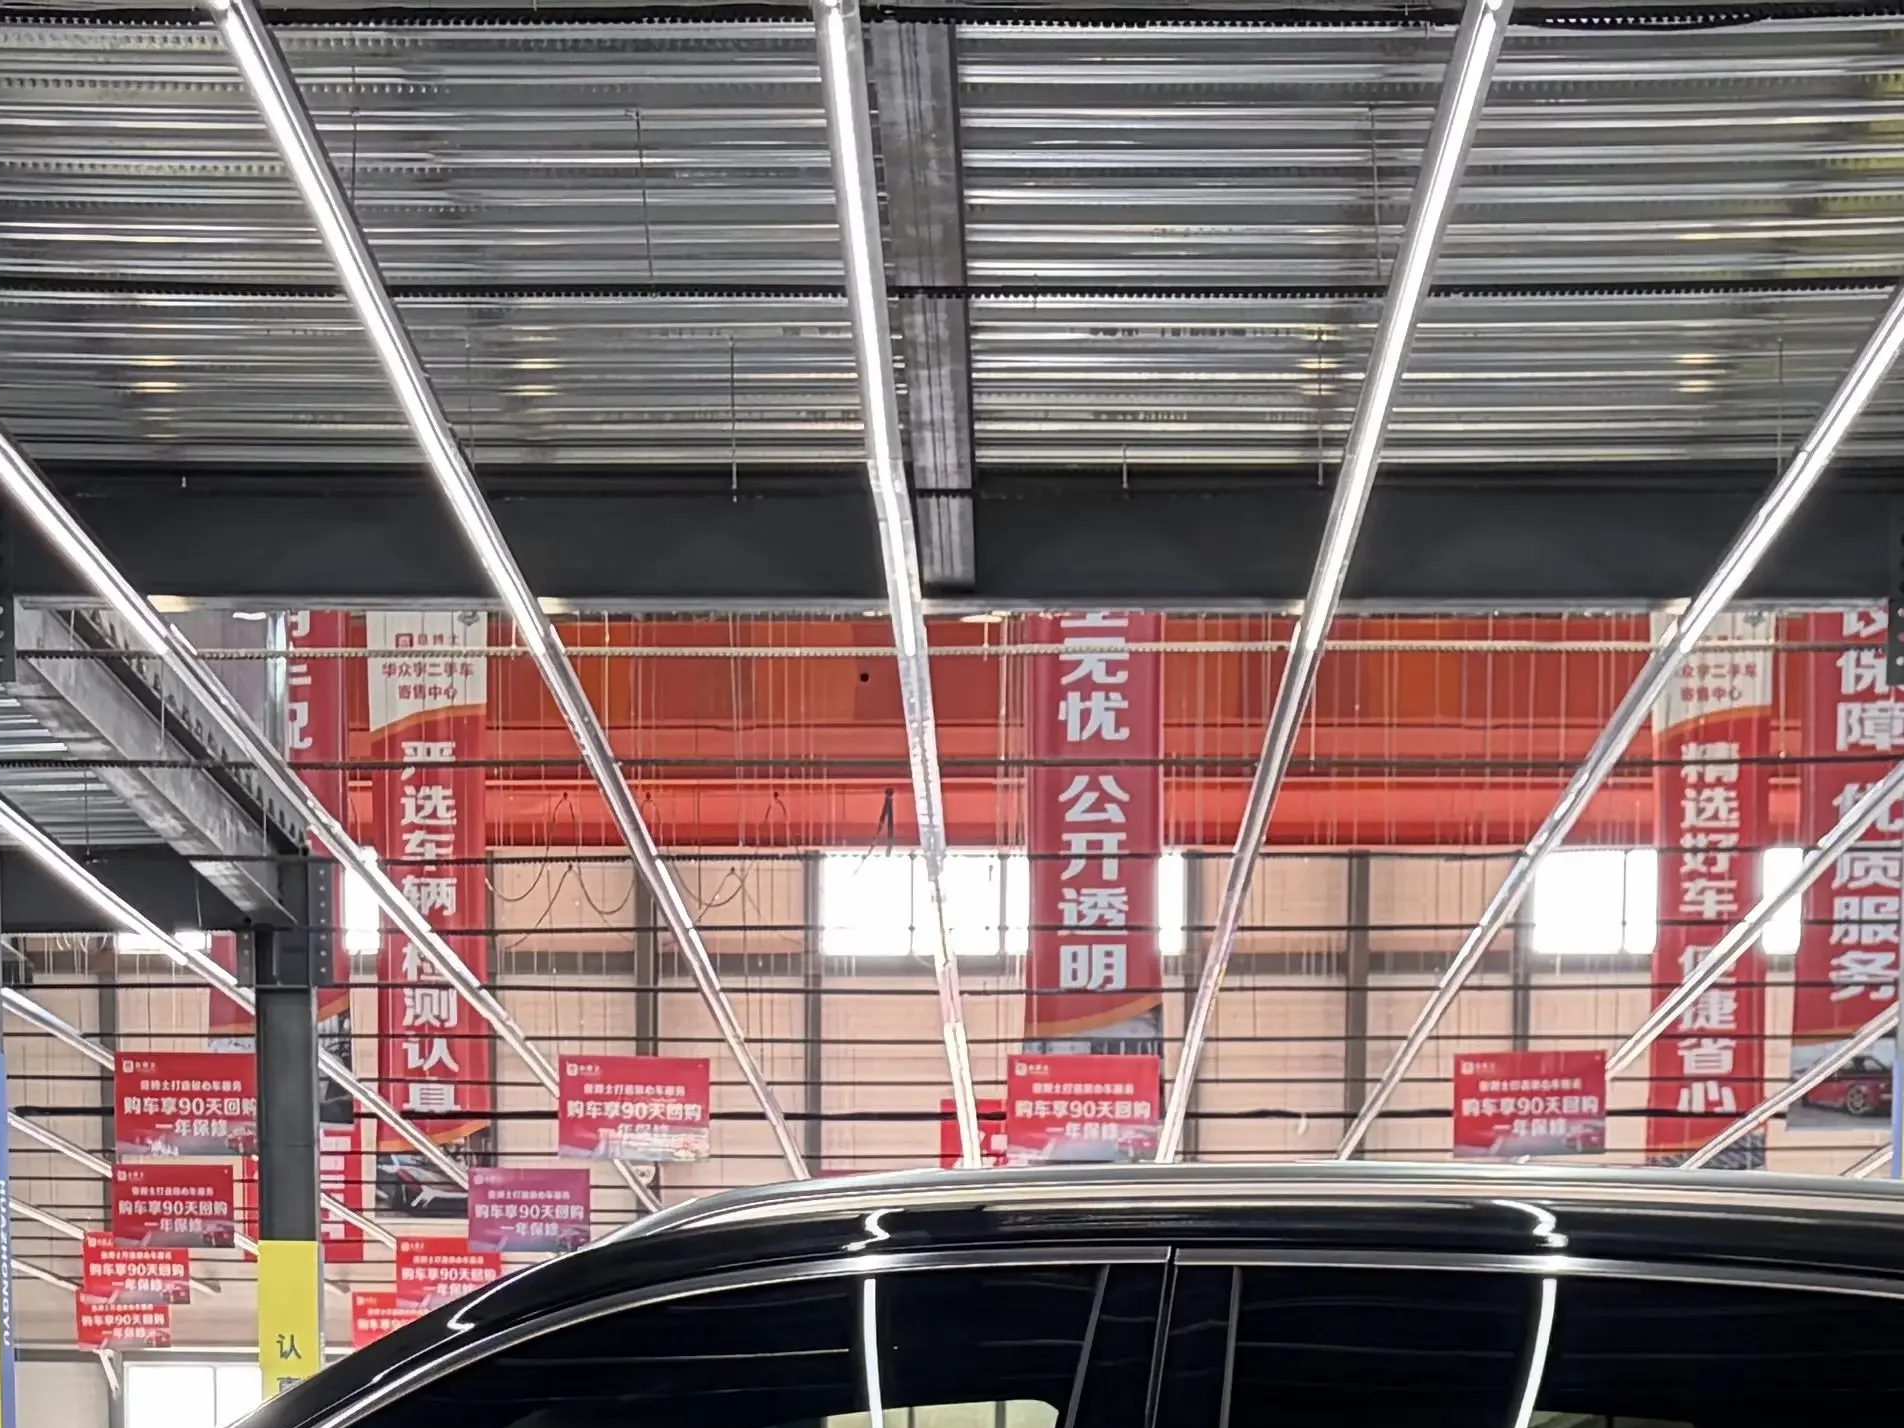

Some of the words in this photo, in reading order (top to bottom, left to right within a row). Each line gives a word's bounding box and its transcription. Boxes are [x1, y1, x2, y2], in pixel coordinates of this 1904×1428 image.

[401, 741, 457, 916] 严选车辆
[1058, 775, 1130, 991] 公开透明
[1679, 742, 1740, 919] 精选好车
[124, 1097, 256, 1115] 购车享90天回购
[567, 1100, 702, 1121] 购车享90天回购
[1015, 1101, 1151, 1119] 购车享90天回购
[0, 1180, 11, 1346] HUAZHONGYU
